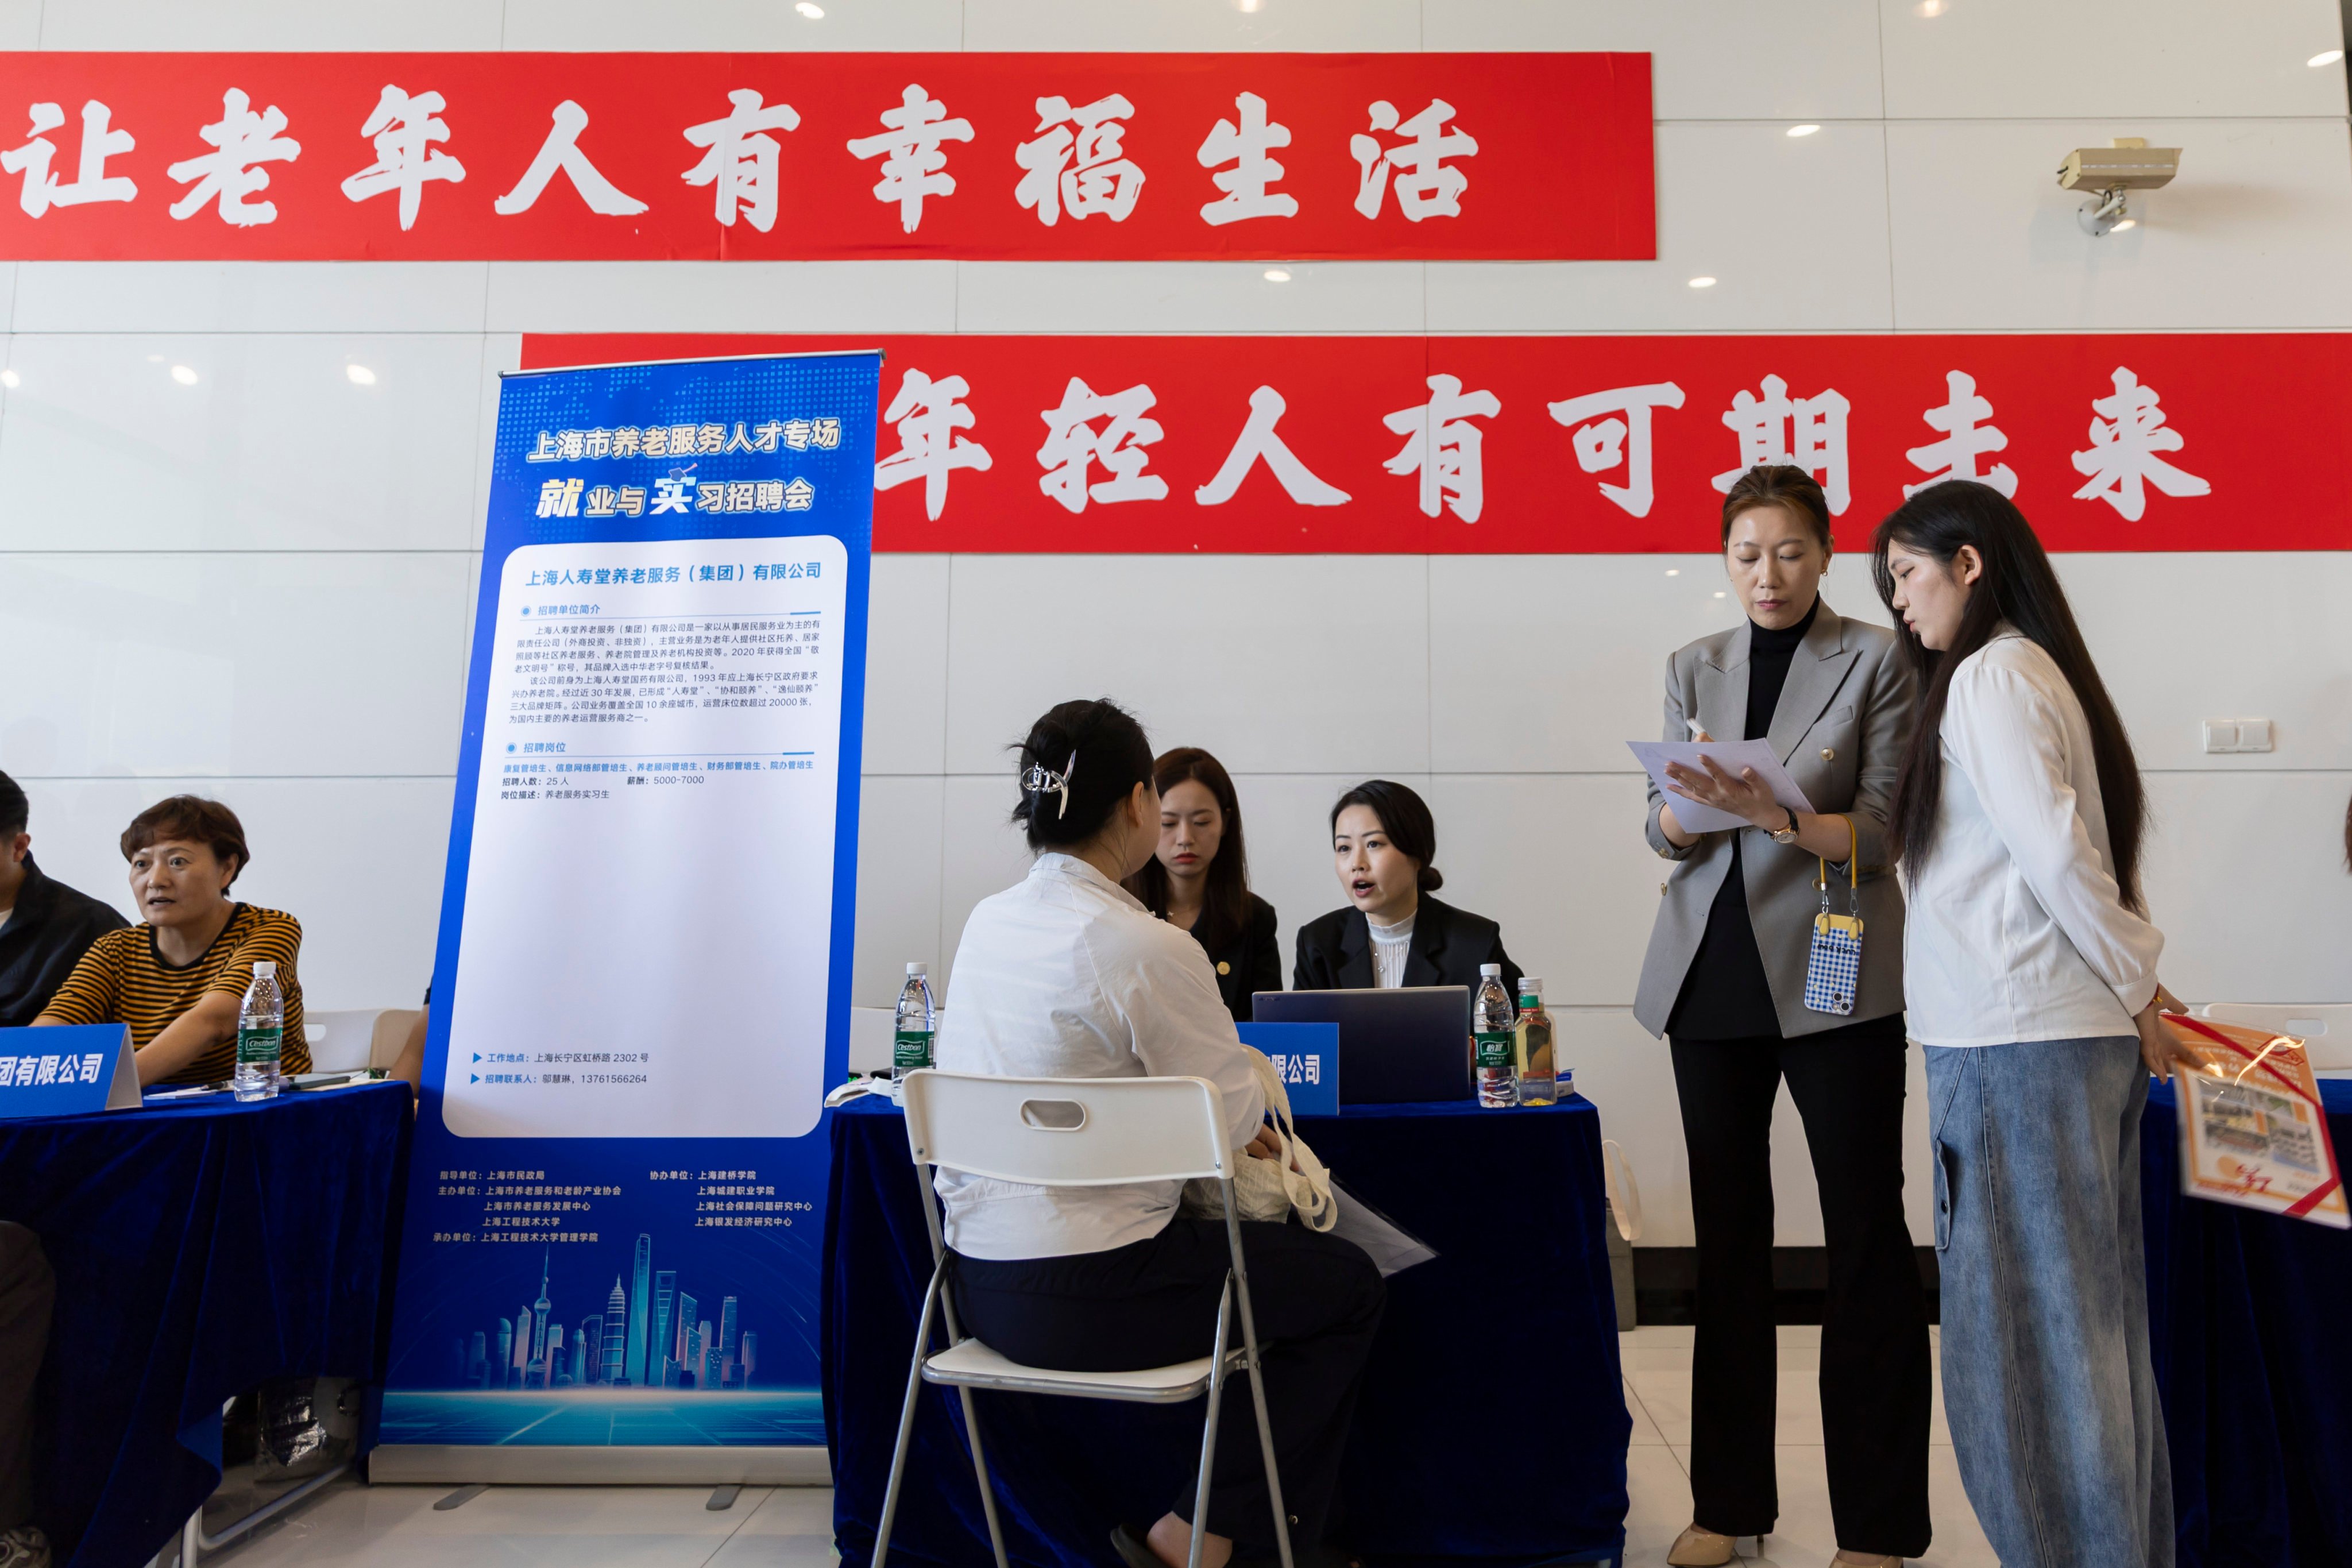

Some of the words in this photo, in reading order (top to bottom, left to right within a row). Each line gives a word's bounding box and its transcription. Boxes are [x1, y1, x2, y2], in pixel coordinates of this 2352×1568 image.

[0, 83, 1479, 233] 让老年人有幸福生活
[527, 418, 840, 461] 上海市养老服务人才专场
[535, 477, 813, 519] 就业与实习招聘会
[525, 561, 821, 586] 上海人寿堂养老服务（集团）有限公司
[538, 604, 601, 616] 招聘单位简介
[524, 742, 566, 753] 招聘岗位
[501, 790, 609, 800] 岗位描述：养老服务实习生
[0, 1053, 103, 1086] 团有限公司
[1267, 1054, 1320, 1084] 限公司
[440, 1171, 545, 1181] 指导单位：上海市民政局
[650, 1171, 756, 1180] 协办单位：上海建桥学院
[438, 1185, 622, 1196] 主办单位：上海市养老服务和老龄产业协会
[697, 1186, 775, 1196] 上海城建职业学院
[484, 1202, 591, 1211] 上海市养老服务发展中心
[696, 1202, 813, 1211] 上海社会保障问题研究中心
[482, 1216, 560, 1227] 上海工程技术大学
[695, 1217, 793, 1227] 上海银发经济研究中心
[433, 1233, 598, 1243] 承办单位：上海工程技术大学管理学院
